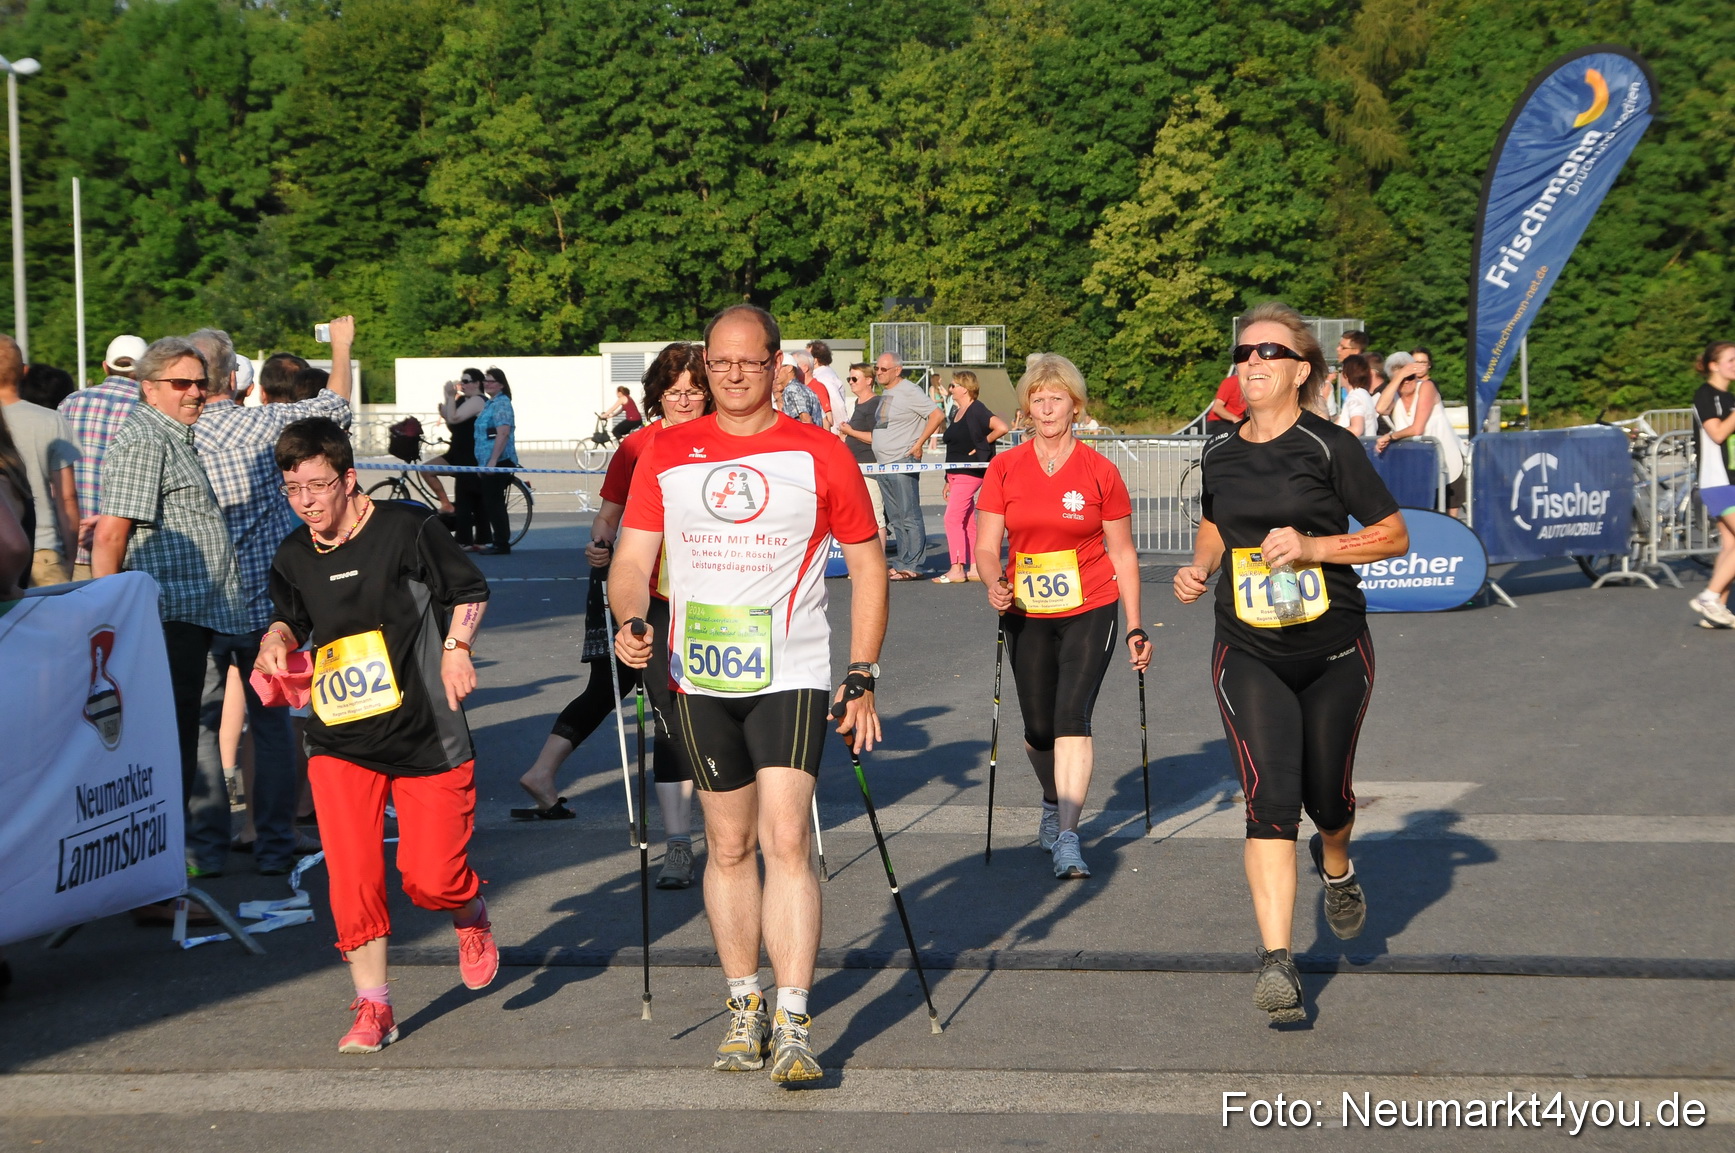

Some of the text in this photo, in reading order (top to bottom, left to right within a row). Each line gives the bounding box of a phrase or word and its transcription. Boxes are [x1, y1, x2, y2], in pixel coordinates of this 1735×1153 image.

[1565, 156, 1597, 196] Druck
[1485, 130, 1603, 289] Frischmann
[1481, 265, 1549, 383] www.frischmann-net.de
[1214, 432, 1229, 441] JAKO
[1531, 482, 1610, 519] Fischer
[682, 532, 788, 547] LAUFEN MIT HERZ
[1537, 522, 1604, 540] AUTOMOBILE
[691, 549, 701, 557] Dr.
[702, 549, 723, 558] Heck
[730, 550, 744, 558] Dr.
[746, 550, 776, 560] Röschl
[691, 560, 774, 573] Leistungsdiagnostik
[1351, 552, 1464, 577] ischer
[1022, 573, 1070, 598] 136
[1239, 569, 1320, 609] 110
[1357, 576, 1455, 590] AUTOMOBILE
[688, 643, 766, 679] 5064
[315, 661, 391, 705] 1092
[76, 763, 153, 824] Neumarkter
[55, 803, 167, 894] Lammsbräu
